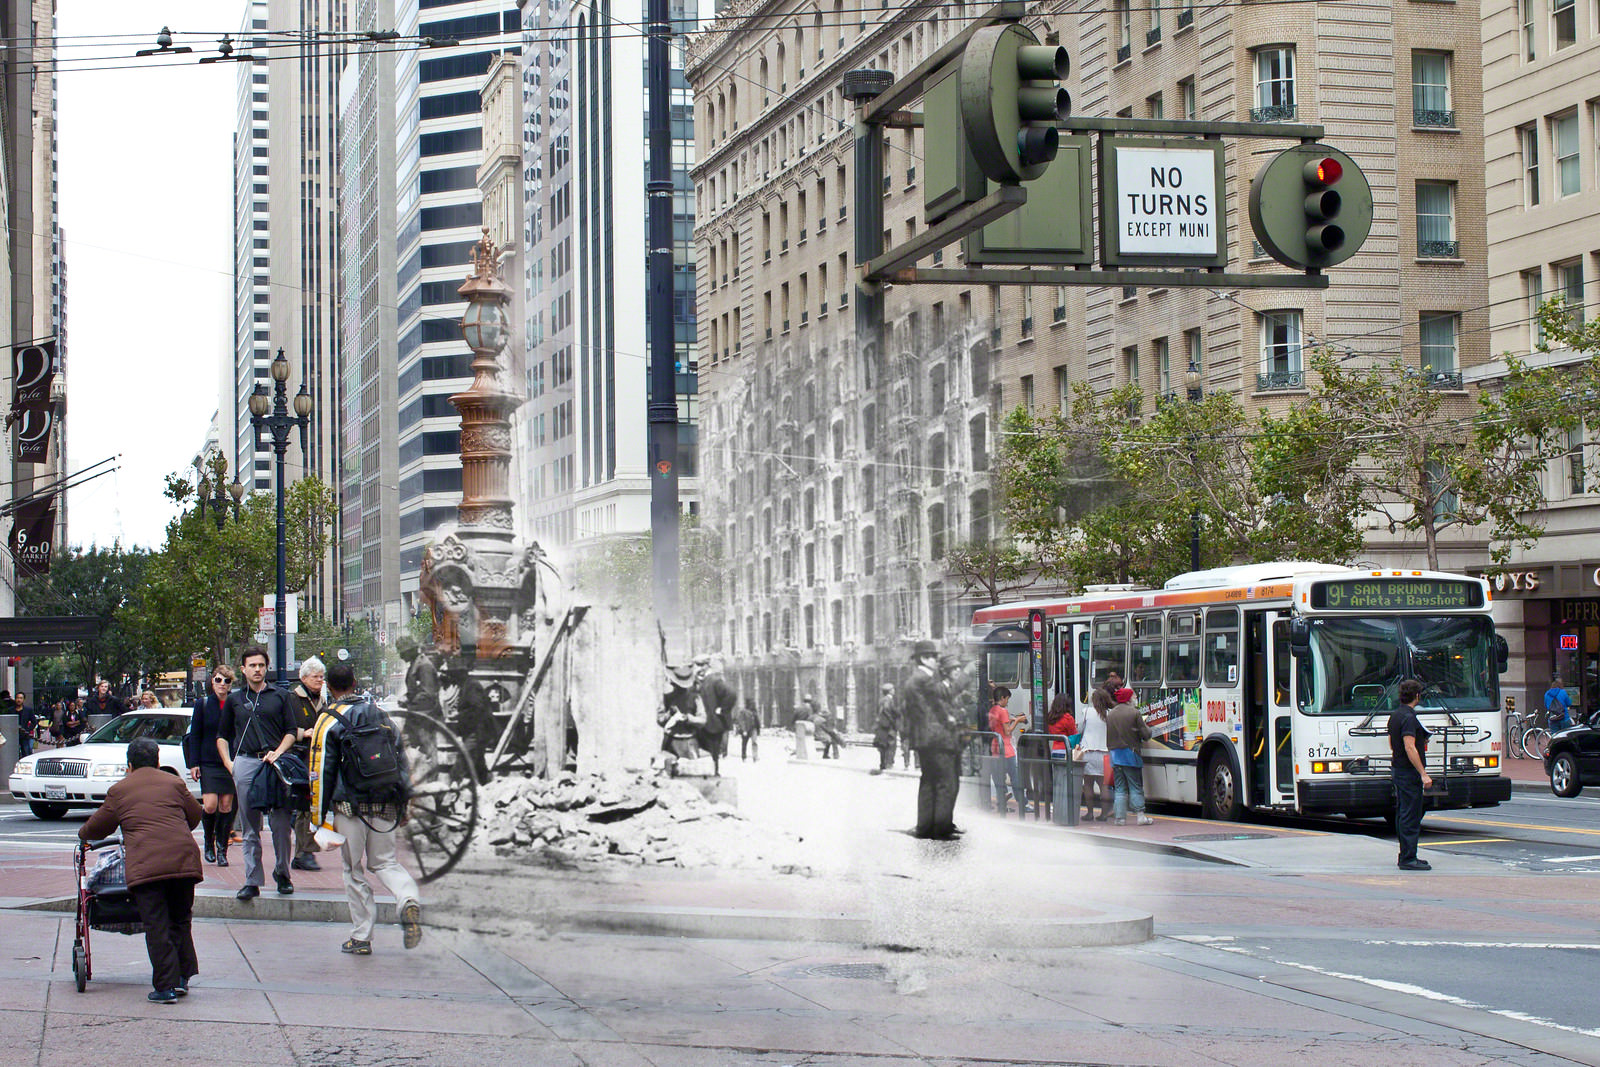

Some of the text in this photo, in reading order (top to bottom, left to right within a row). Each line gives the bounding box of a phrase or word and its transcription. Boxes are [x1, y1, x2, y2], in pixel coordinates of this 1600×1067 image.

[1151, 166, 1182, 188] NO
[1127, 194, 1208, 216] TURNS
[1128, 222, 1209, 238] EXCEPT MUNI
[1329, 583, 1348, 606] 9L
[1353, 583, 1464, 595] SAN BRUNO LTD
[1350, 595, 1391, 606] Arleta
[1406, 594, 1466, 606] Bayshore
[1561, 636, 1577, 648] OPEN
[1308, 747, 1337, 758] 8174
